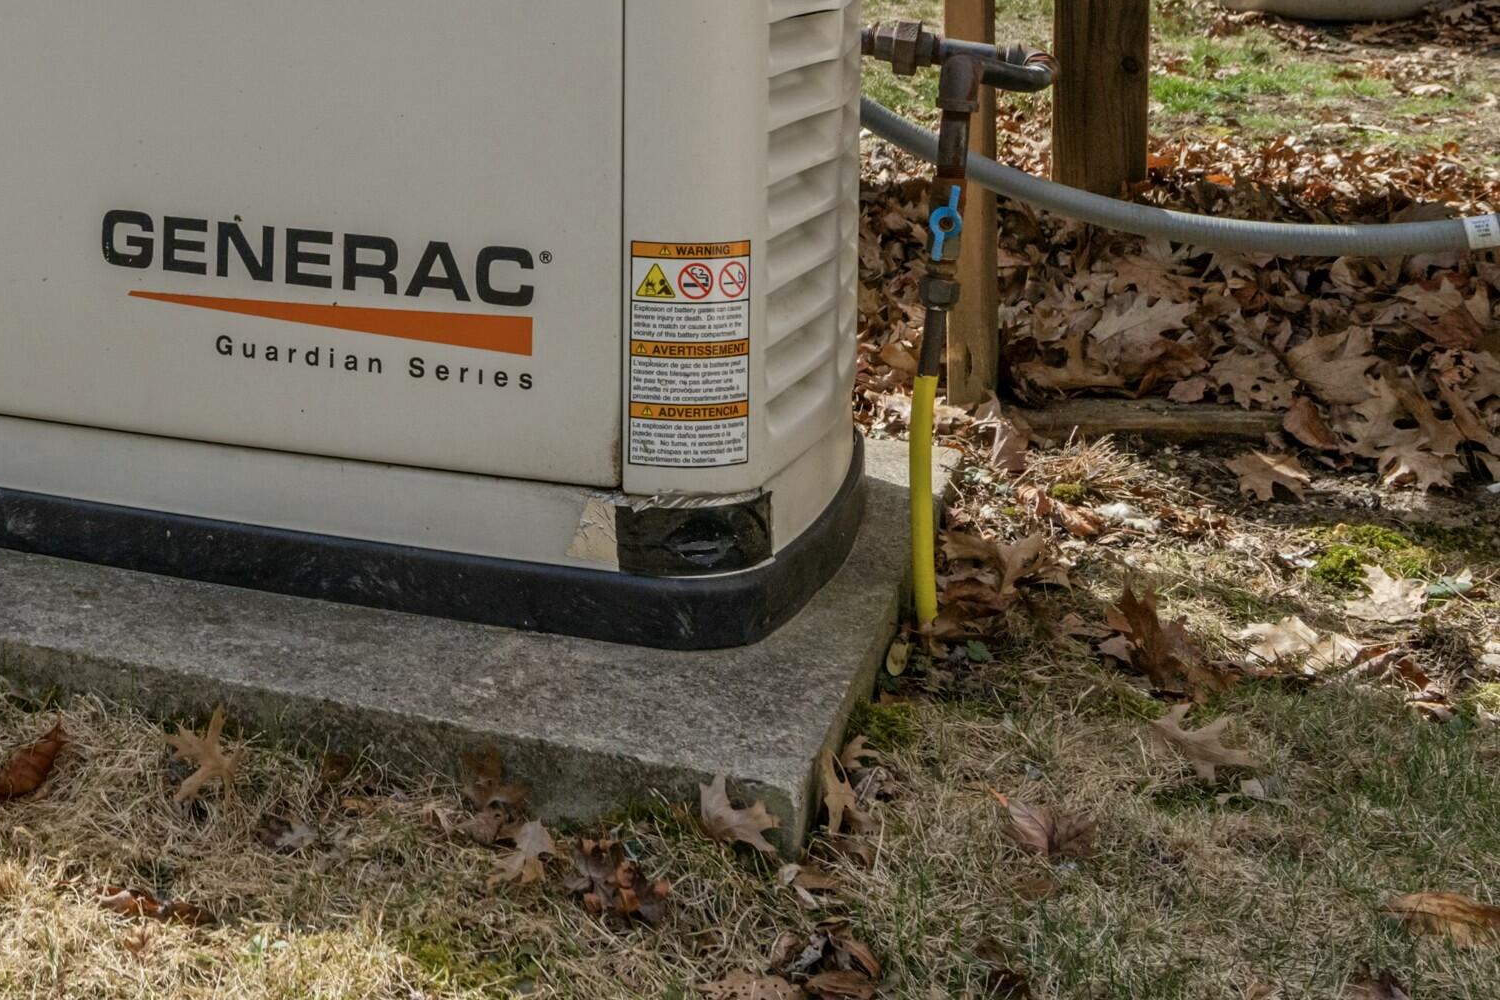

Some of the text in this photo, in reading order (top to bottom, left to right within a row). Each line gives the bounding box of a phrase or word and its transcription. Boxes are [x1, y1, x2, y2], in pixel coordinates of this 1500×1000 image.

[676, 245, 730, 256] WARNING
[101, 209, 535, 307] GENERAC
[634, 305, 665, 313] Explosion
[652, 342, 746, 355] AVERTISSEMENT
[215, 334, 534, 390] Guardian Series
[658, 405, 740, 418] ADVERTENCIA
